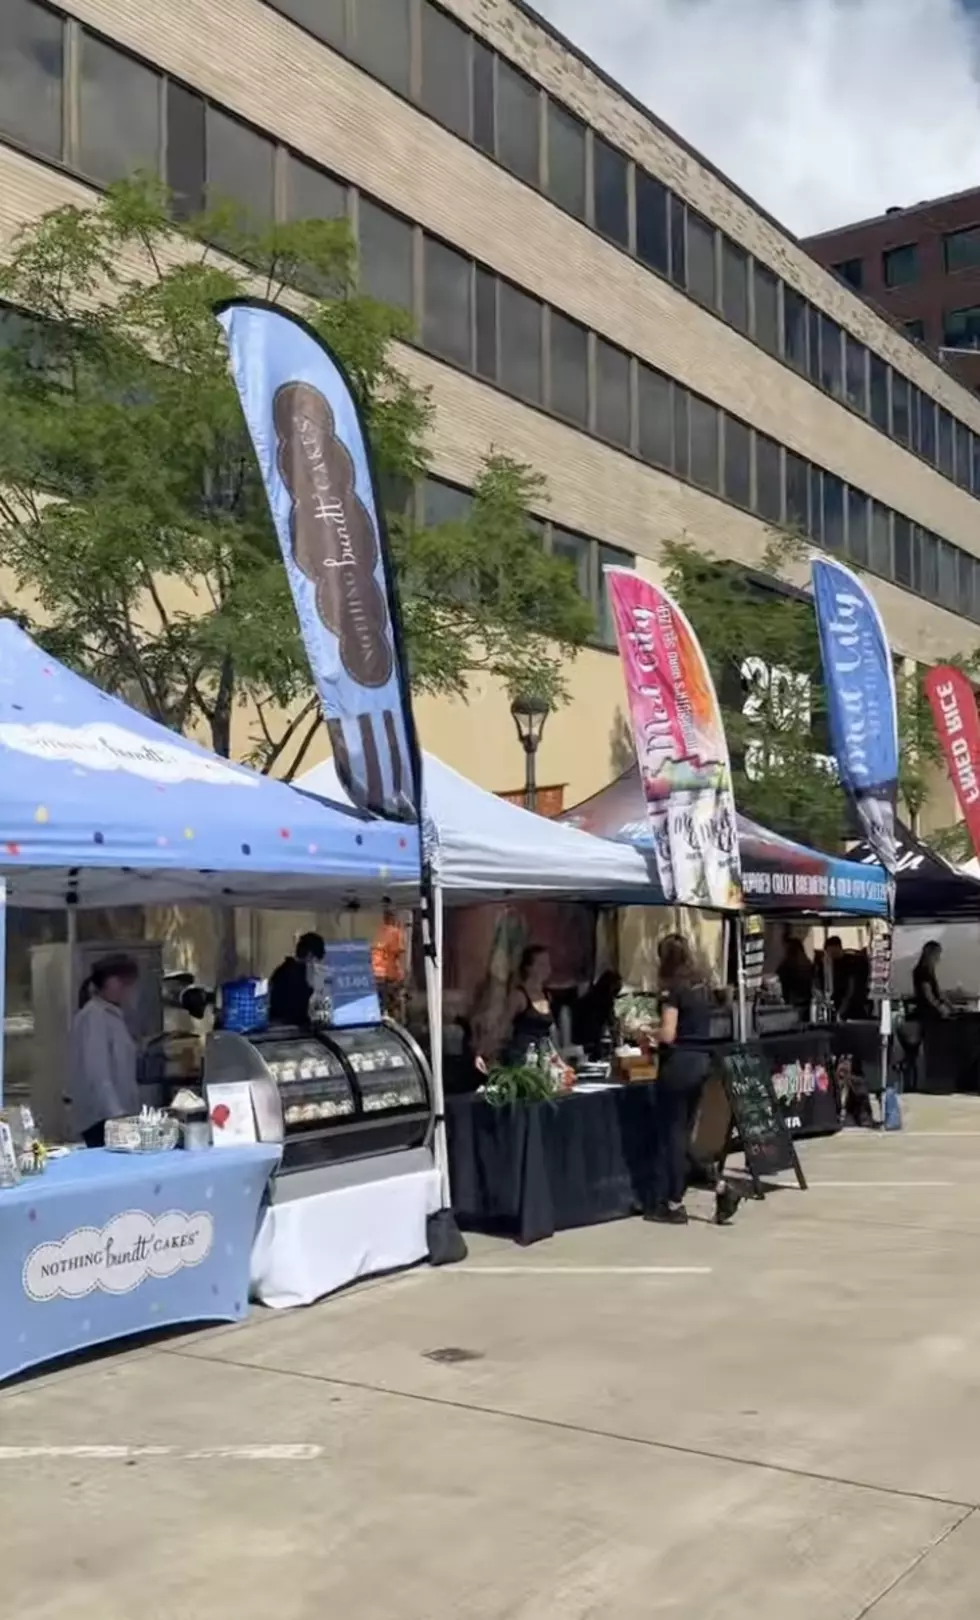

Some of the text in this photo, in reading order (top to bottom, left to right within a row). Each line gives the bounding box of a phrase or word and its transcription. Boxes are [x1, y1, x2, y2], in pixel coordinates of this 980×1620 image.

[312, 496, 356, 568] bundt
[342, 571, 374, 664] NOTHING
[627, 607, 674, 757] Med City
[41, 1234, 195, 1278] NOTHING bundt CAKES
